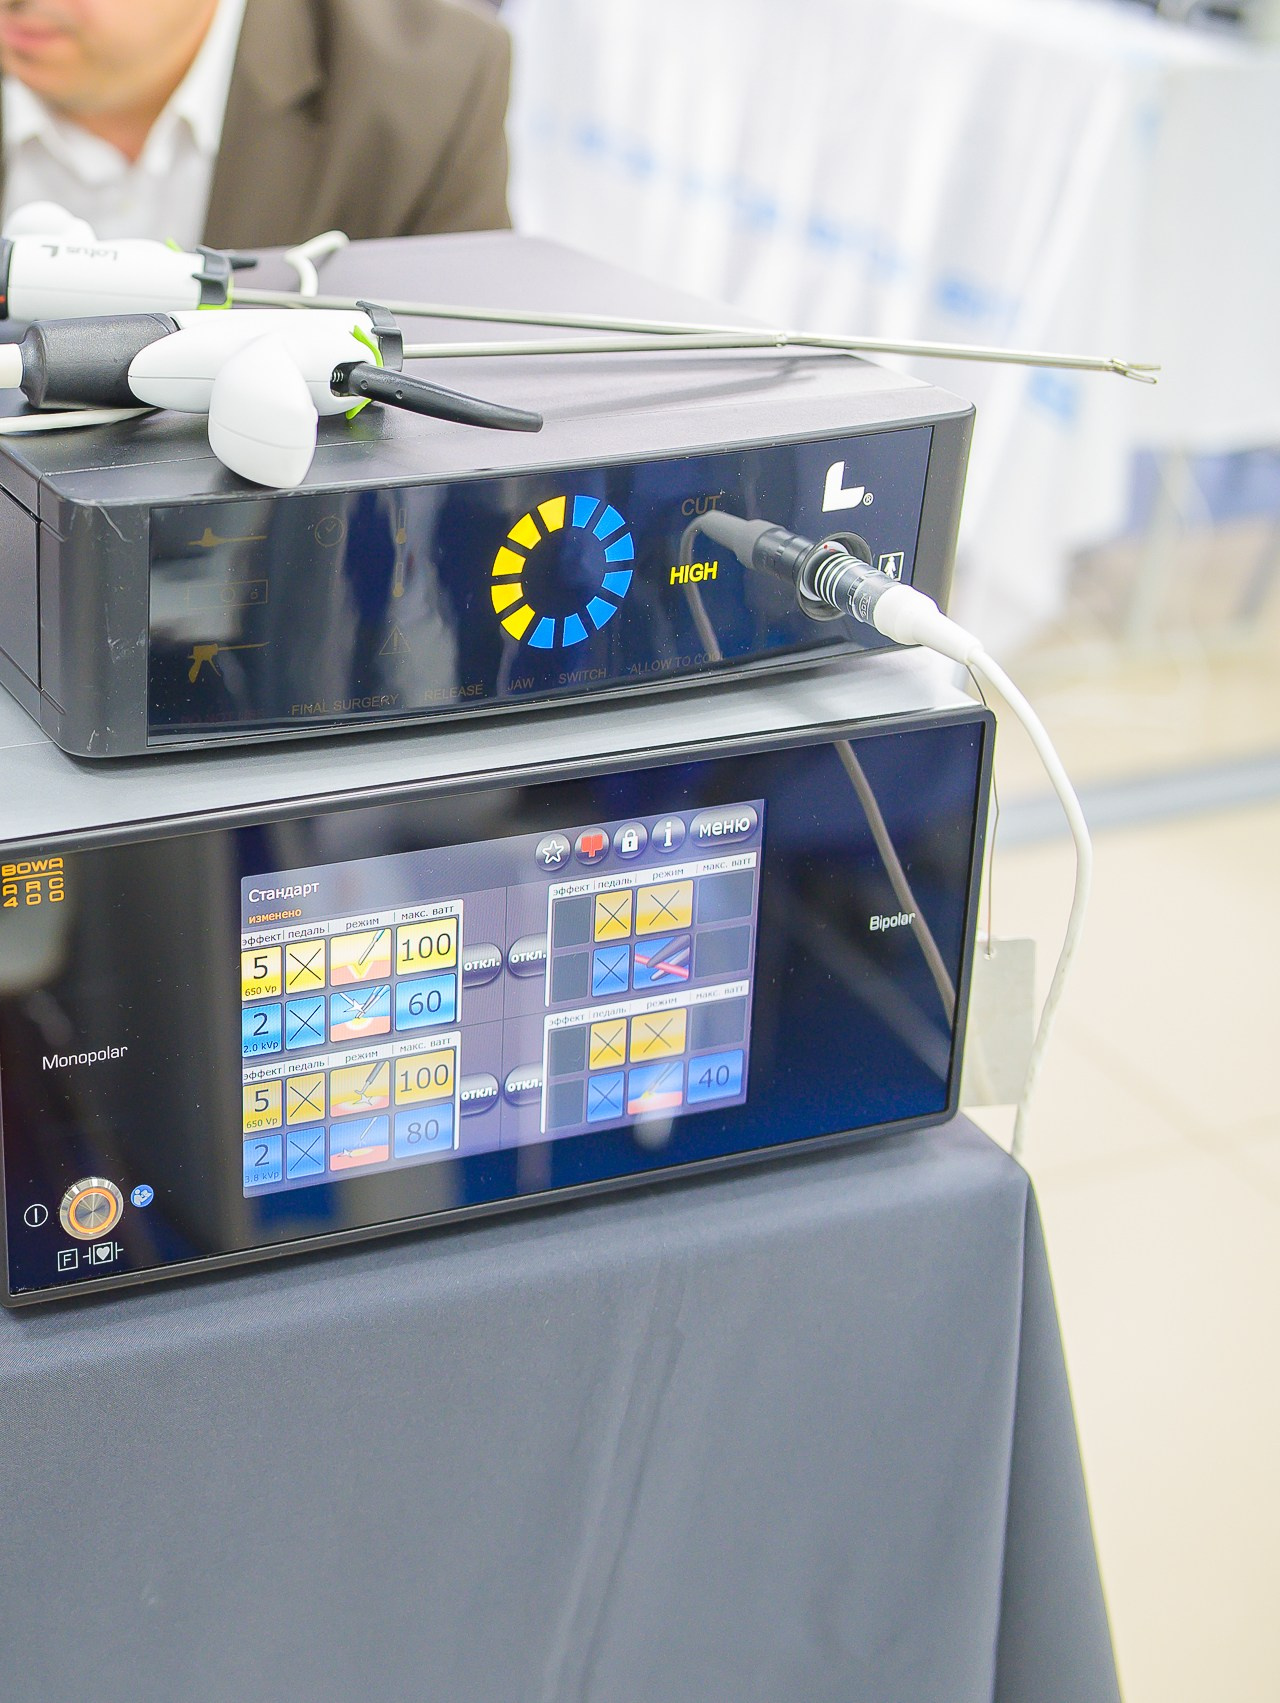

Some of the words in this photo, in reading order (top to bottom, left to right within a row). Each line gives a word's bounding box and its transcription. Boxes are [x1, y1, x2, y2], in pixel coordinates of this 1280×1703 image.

[681, 495, 720, 516] CUT
[670, 561, 718, 585] HIGH
[630, 659, 671, 675] ALLOW
[675, 655, 690, 667] TO
[507, 677, 534, 691] JAW
[559, 668, 607, 684] SWITCH
[424, 684, 483, 701] RELEASE
[291, 702, 329, 716] FINAL
[333, 693, 399, 711] SURGERY
[699, 817, 751, 839] меню
[2, 857, 63, 877] BOWA
[652, 868, 684, 881] режим
[2, 877, 64, 896] ARC
[553, 882, 590, 897] эффект
[598, 876, 633, 891] педаль
[3, 890, 65, 908] 400
[248, 882, 320, 903] Стандарт
[248, 908, 302, 924] изменено
[401, 909, 428, 920] макс.
[432, 904, 454, 915] ватт
[345, 917, 379, 931] режим
[869, 912, 916, 932] Bipolar
[242, 932, 282, 947] эффект
[288, 925, 325, 939] педаль
[401, 933, 451, 962] 100
[463, 956, 501, 972] откл.
[510, 948, 547, 964] откл.
[253, 955, 268, 980] 5
[244, 986, 262, 997] 650
[264, 984, 277, 996] Vp
[408, 989, 442, 1016] 60
[253, 1012, 269, 1037] 2
[243, 1043, 259, 1054] 2.0
[261, 1040, 279, 1052] kVp
[399, 1042, 426, 1053] макс.
[430, 1037, 451, 1048] ватт
[42, 1045, 128, 1070] Monopolar
[345, 1050, 378, 1064] режим
[243, 1066, 282, 1081] эффект
[288, 1058, 325, 1073] педаль
[400, 1064, 449, 1093] 100
[699, 1065, 730, 1088] 40
[507, 1078, 543, 1093] откл.
[254, 1088, 269, 1112] 5
[461, 1087, 497, 1102] откл.
[246, 1118, 263, 1129] 650
[265, 1116, 278, 1127] Vp
[407, 1119, 440, 1145] 80
[254, 1144, 270, 1167] 2
